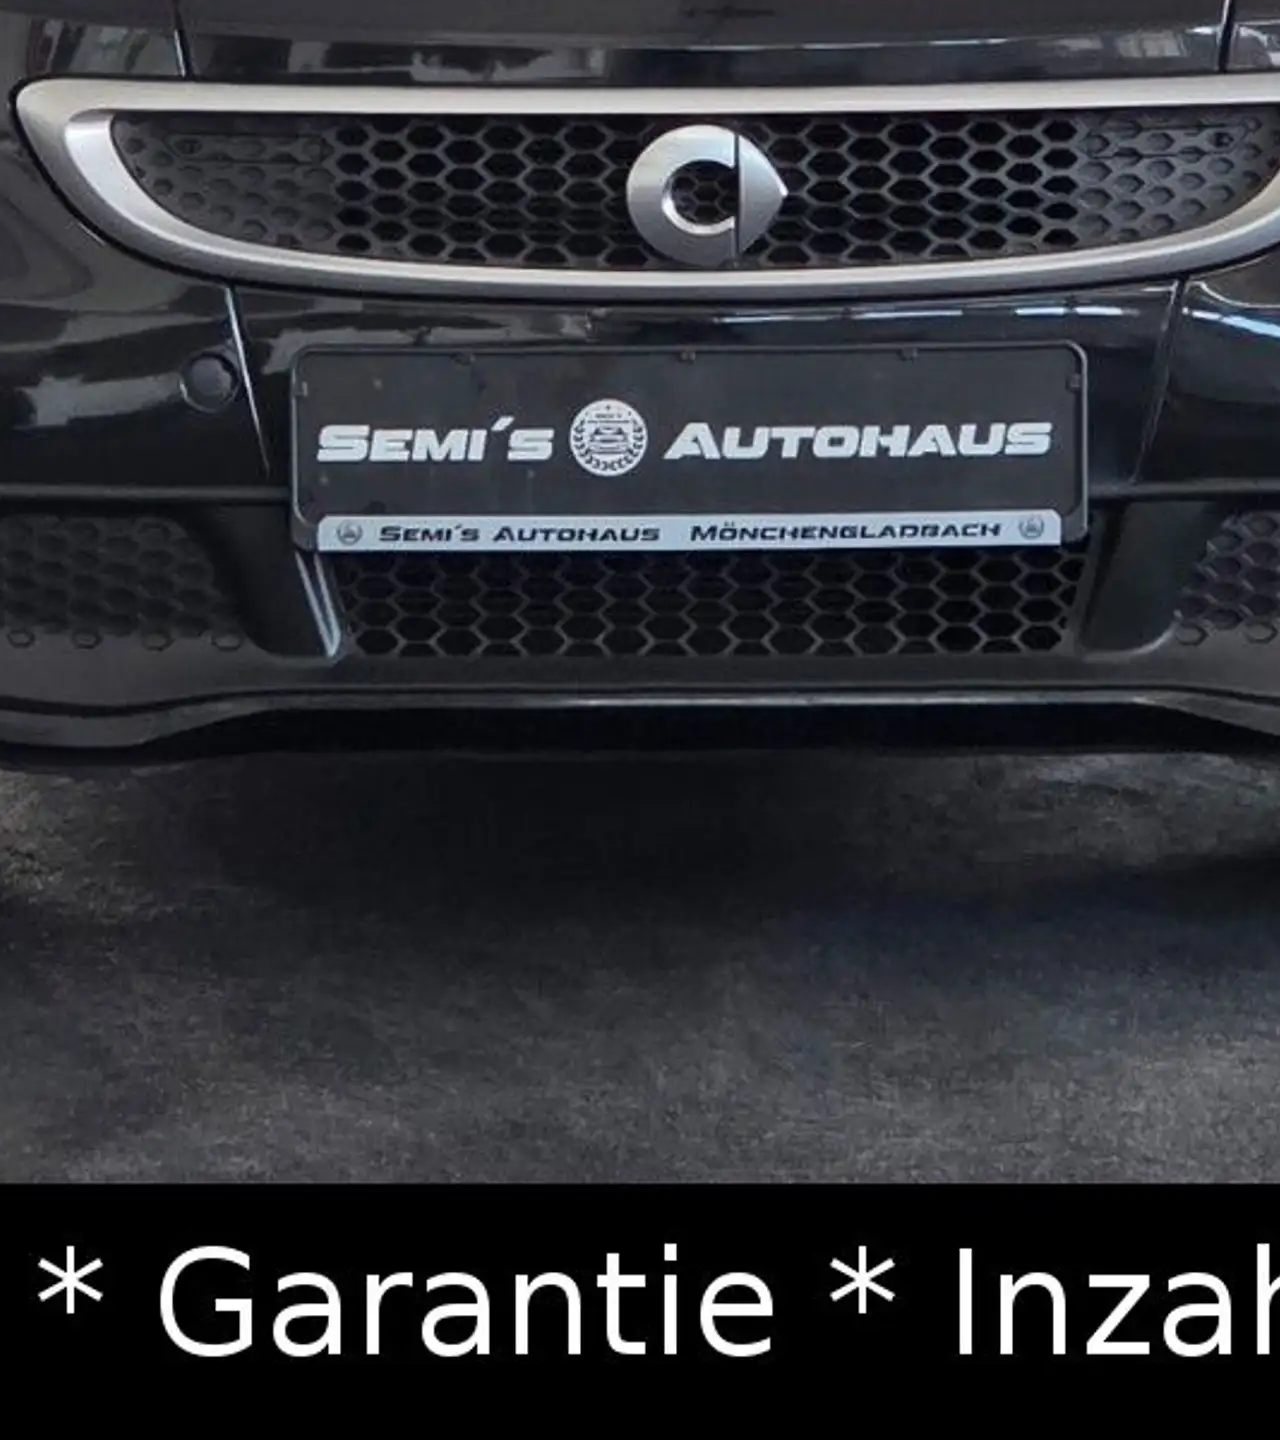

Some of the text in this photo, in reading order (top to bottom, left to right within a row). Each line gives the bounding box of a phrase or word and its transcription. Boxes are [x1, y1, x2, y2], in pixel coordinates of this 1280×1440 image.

[663, 422, 1053, 461] AUTOHAUS
[492, 524, 661, 544] AUTOHAUS
[689, 522, 1002, 542] MÖNCHENGLADBACH
